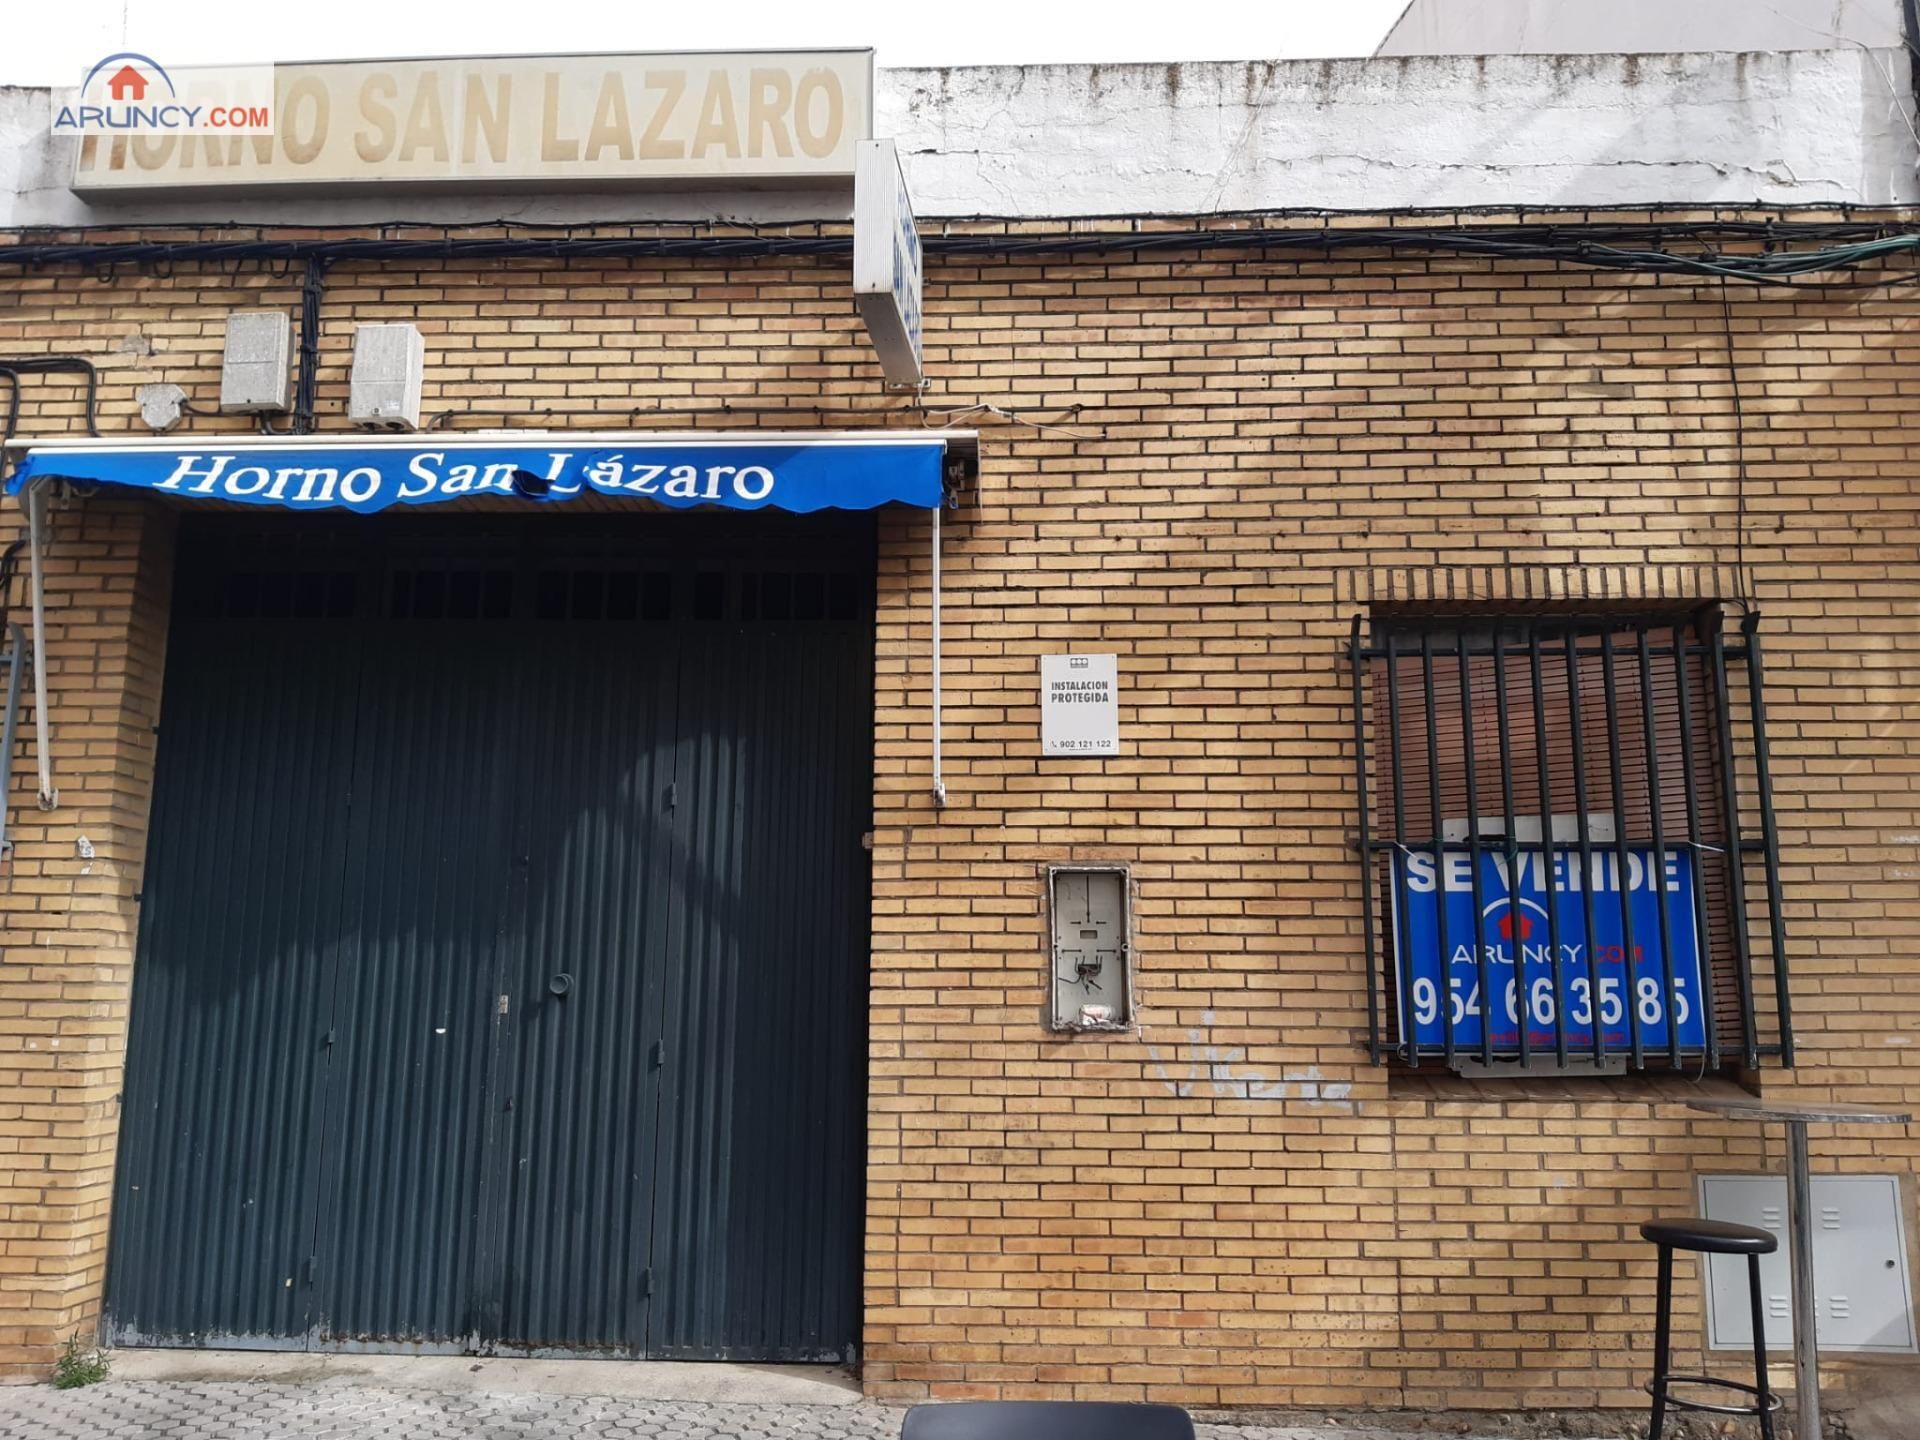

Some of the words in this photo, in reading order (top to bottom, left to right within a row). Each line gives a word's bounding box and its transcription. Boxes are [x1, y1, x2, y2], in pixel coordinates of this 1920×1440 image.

[354, 69, 512, 164] SAN
[540, 66, 844, 162] LAZARO
[152, 455, 382, 502] Horno
[397, 453, 518, 498] San
[548, 452, 775, 500] Lázaro
[1051, 680, 1108, 690] INSTALACION
[1051, 692, 1109, 703] PROTEGIDA
[1060, 740, 1075, 748] 902
[1078, 740, 1093, 748] 121
[1096, 739, 1111, 748] 122
[1406, 851, 1473, 892] SE
[1490, 851, 1680, 892] VENDE
[1413, 976, 1492, 1025] 954
[1505, 976, 1556, 1025] 66
[1570, 976, 1623, 1025] 35
[1637, 976, 1689, 1025] 85
